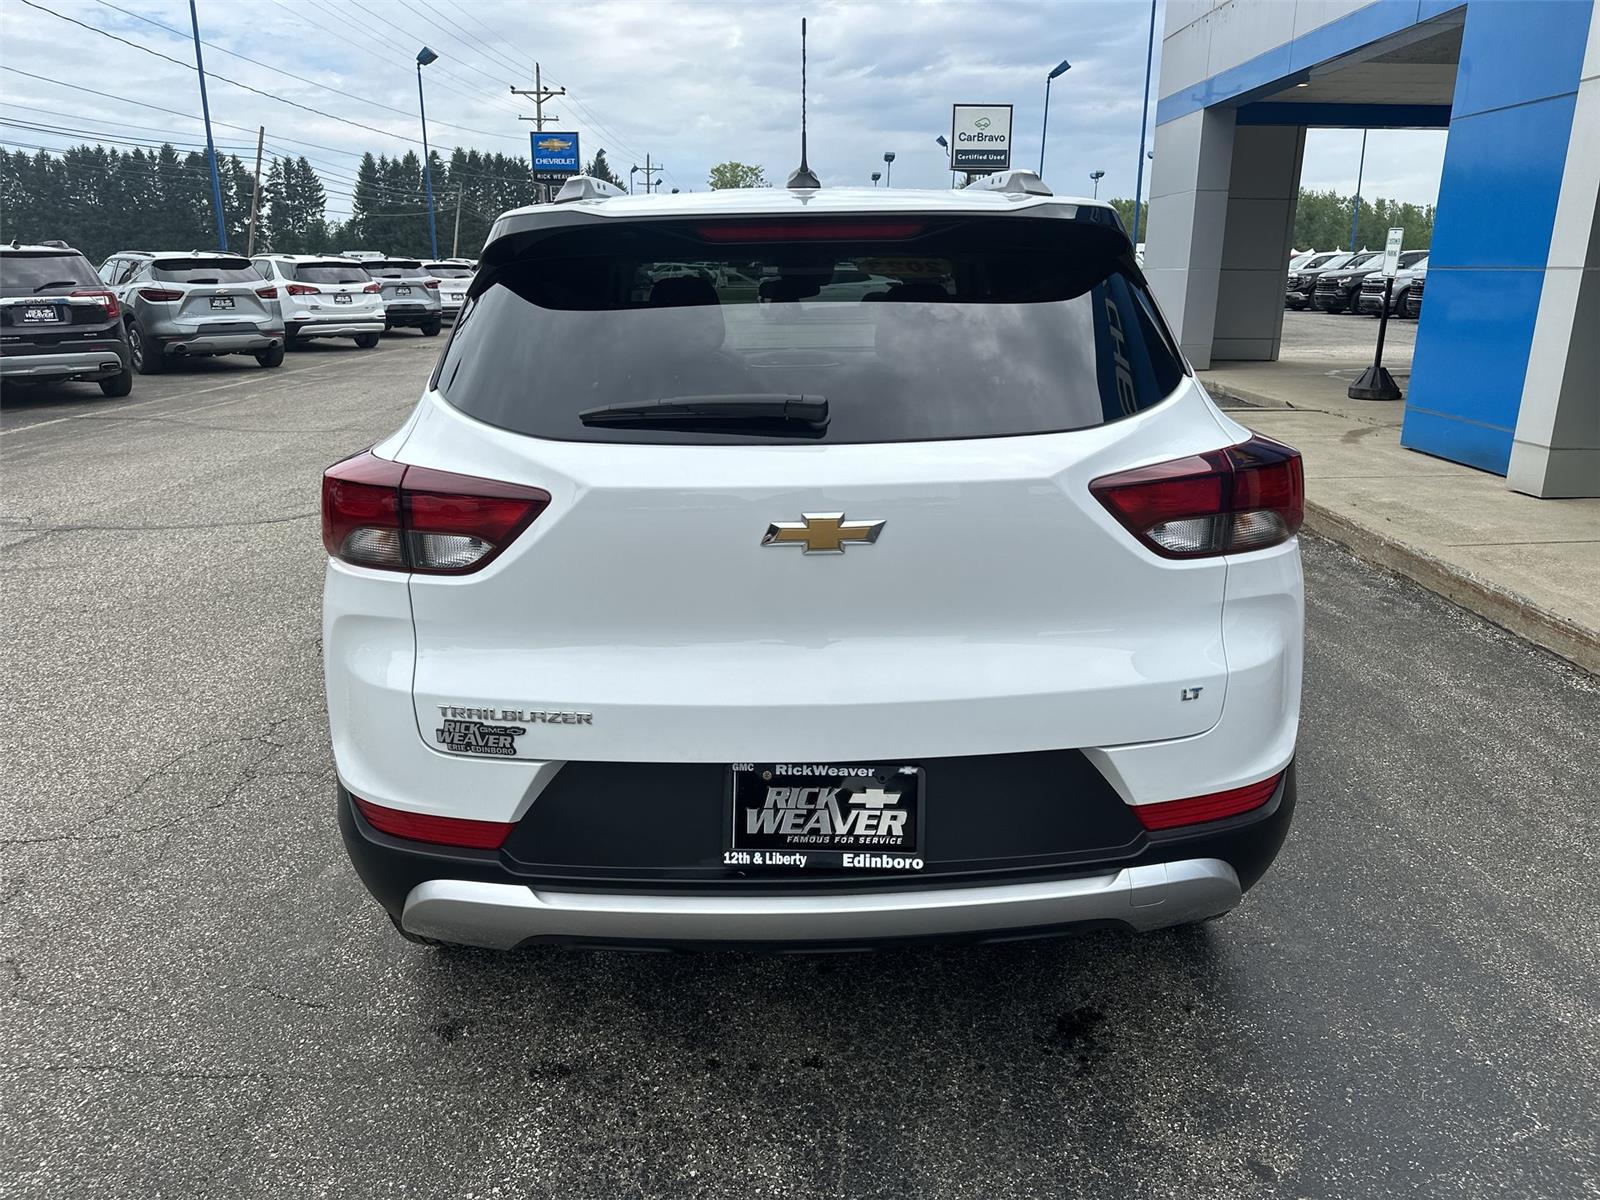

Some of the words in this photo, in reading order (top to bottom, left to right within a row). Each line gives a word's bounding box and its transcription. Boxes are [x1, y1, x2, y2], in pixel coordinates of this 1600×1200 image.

[958, 132, 1006, 142] CarBravo
[1181, 686, 1204, 701] LT
[436, 703, 593, 725] TRAILBLAZER
[444, 720, 481, 735] RICK
[437, 730, 512, 748] WEAVER
[447, 744, 467, 752] ERIE
[470, 746, 515, 756] EDINBORO
[732, 763, 754, 772] GMC
[764, 787, 842, 810] RICK
[746, 808, 908, 836] WEAVER
[786, 835, 830, 844] FAMOUS
[834, 836, 854, 844] FOR
[859, 836, 903, 845] SERVICE
[723, 852, 750, 865] 12th
[753, 853, 763, 865] &
[765, 852, 807, 868] Liberty
[842, 853, 924, 870] Edinboro
